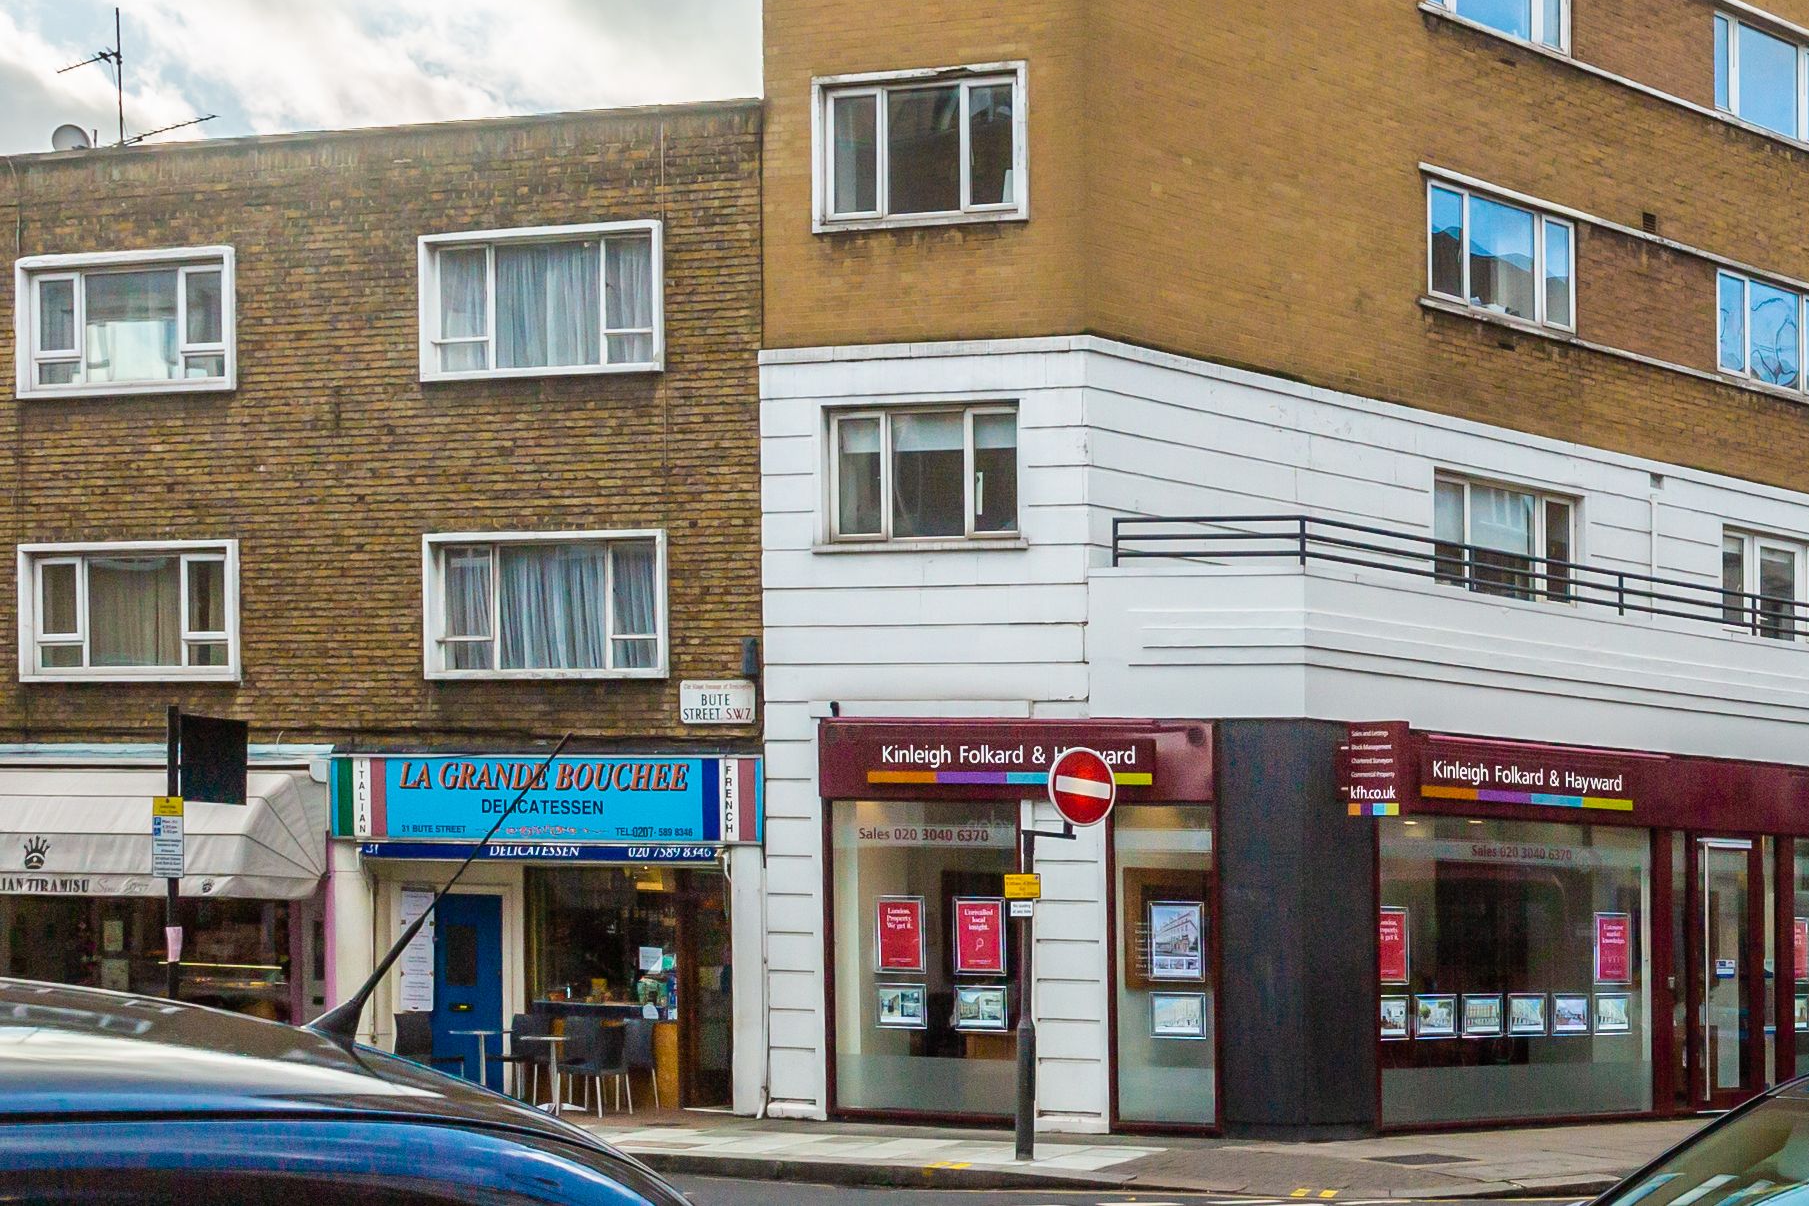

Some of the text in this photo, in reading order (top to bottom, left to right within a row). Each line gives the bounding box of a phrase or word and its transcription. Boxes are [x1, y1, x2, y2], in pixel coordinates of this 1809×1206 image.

[701, 694, 730, 706] BUTE
[683, 708, 720, 720] STREET
[882, 745, 951, 768] Kinleigh
[960, 746, 1023, 764] Folkard
[1032, 747, 1046, 764] &
[399, 761, 690, 792] LA GRANDE BOUCHEE
[1433, 760, 1623, 793] Kinleigh Folkard & Hayward
[358, 760, 366, 833] ITALIAN
[725, 765, 733, 833] FRENCH
[1351, 785, 1396, 799] kfh.co.uk
[481, 799, 603, 815] DELICATESSEN
[401, 825, 467, 834] 31 BUTE STREET
[658, 828, 673, 837] 589
[674, 828, 693, 837] 8346
[859, 828, 989, 842] Sales 020 3040 6370
[489, 846, 580, 856] DELICATESSEN
[628, 847, 650, 858] 020
[683, 847, 712, 858] 8346
[1472, 845, 1497, 857] Sales
[1500, 846, 1519, 858] 020
[0, 878, 24, 891] IAN
[27, 879, 89, 893] TIRAMISU
